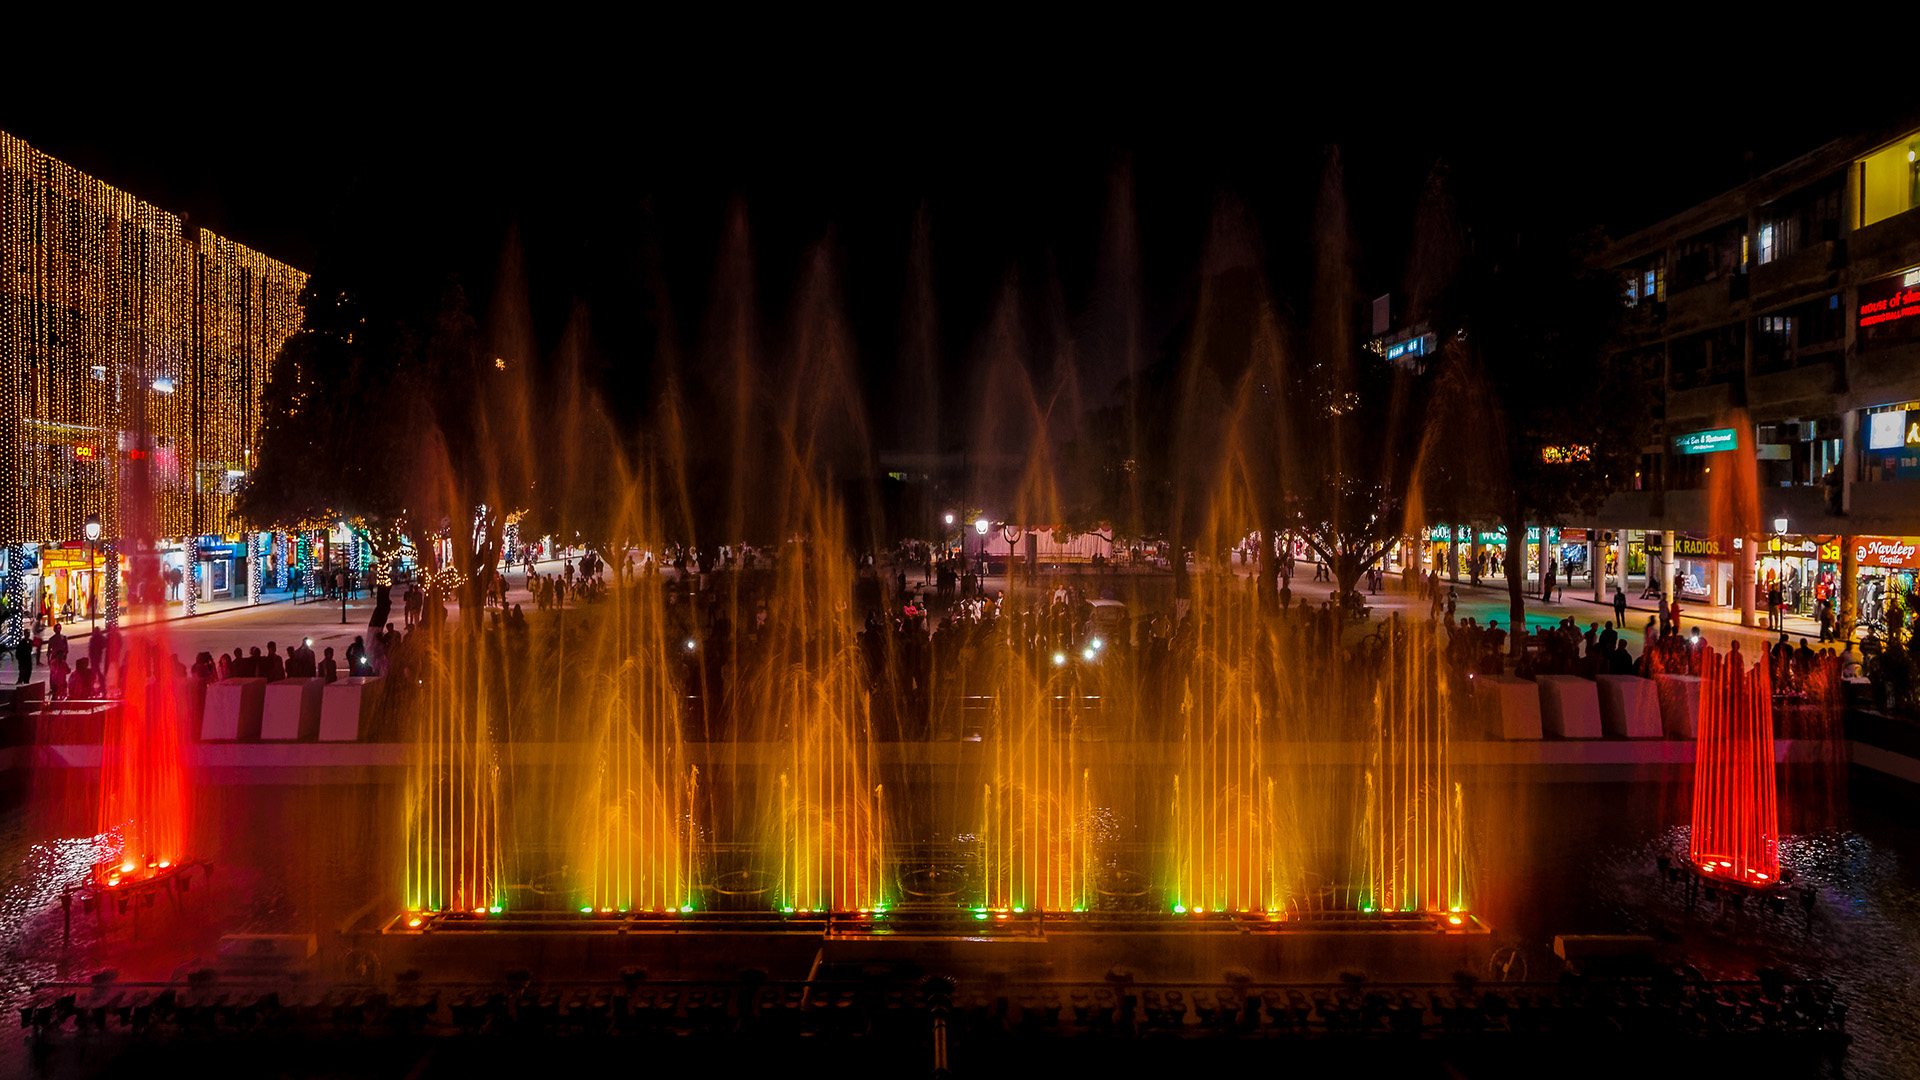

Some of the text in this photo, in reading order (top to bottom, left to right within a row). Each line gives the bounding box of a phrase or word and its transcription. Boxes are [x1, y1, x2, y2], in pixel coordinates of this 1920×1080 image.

[1684, 540, 1719, 555] RADIOS
[1868, 541, 1915, 559] Navdeep
[1879, 555, 1903, 565] Textiles
